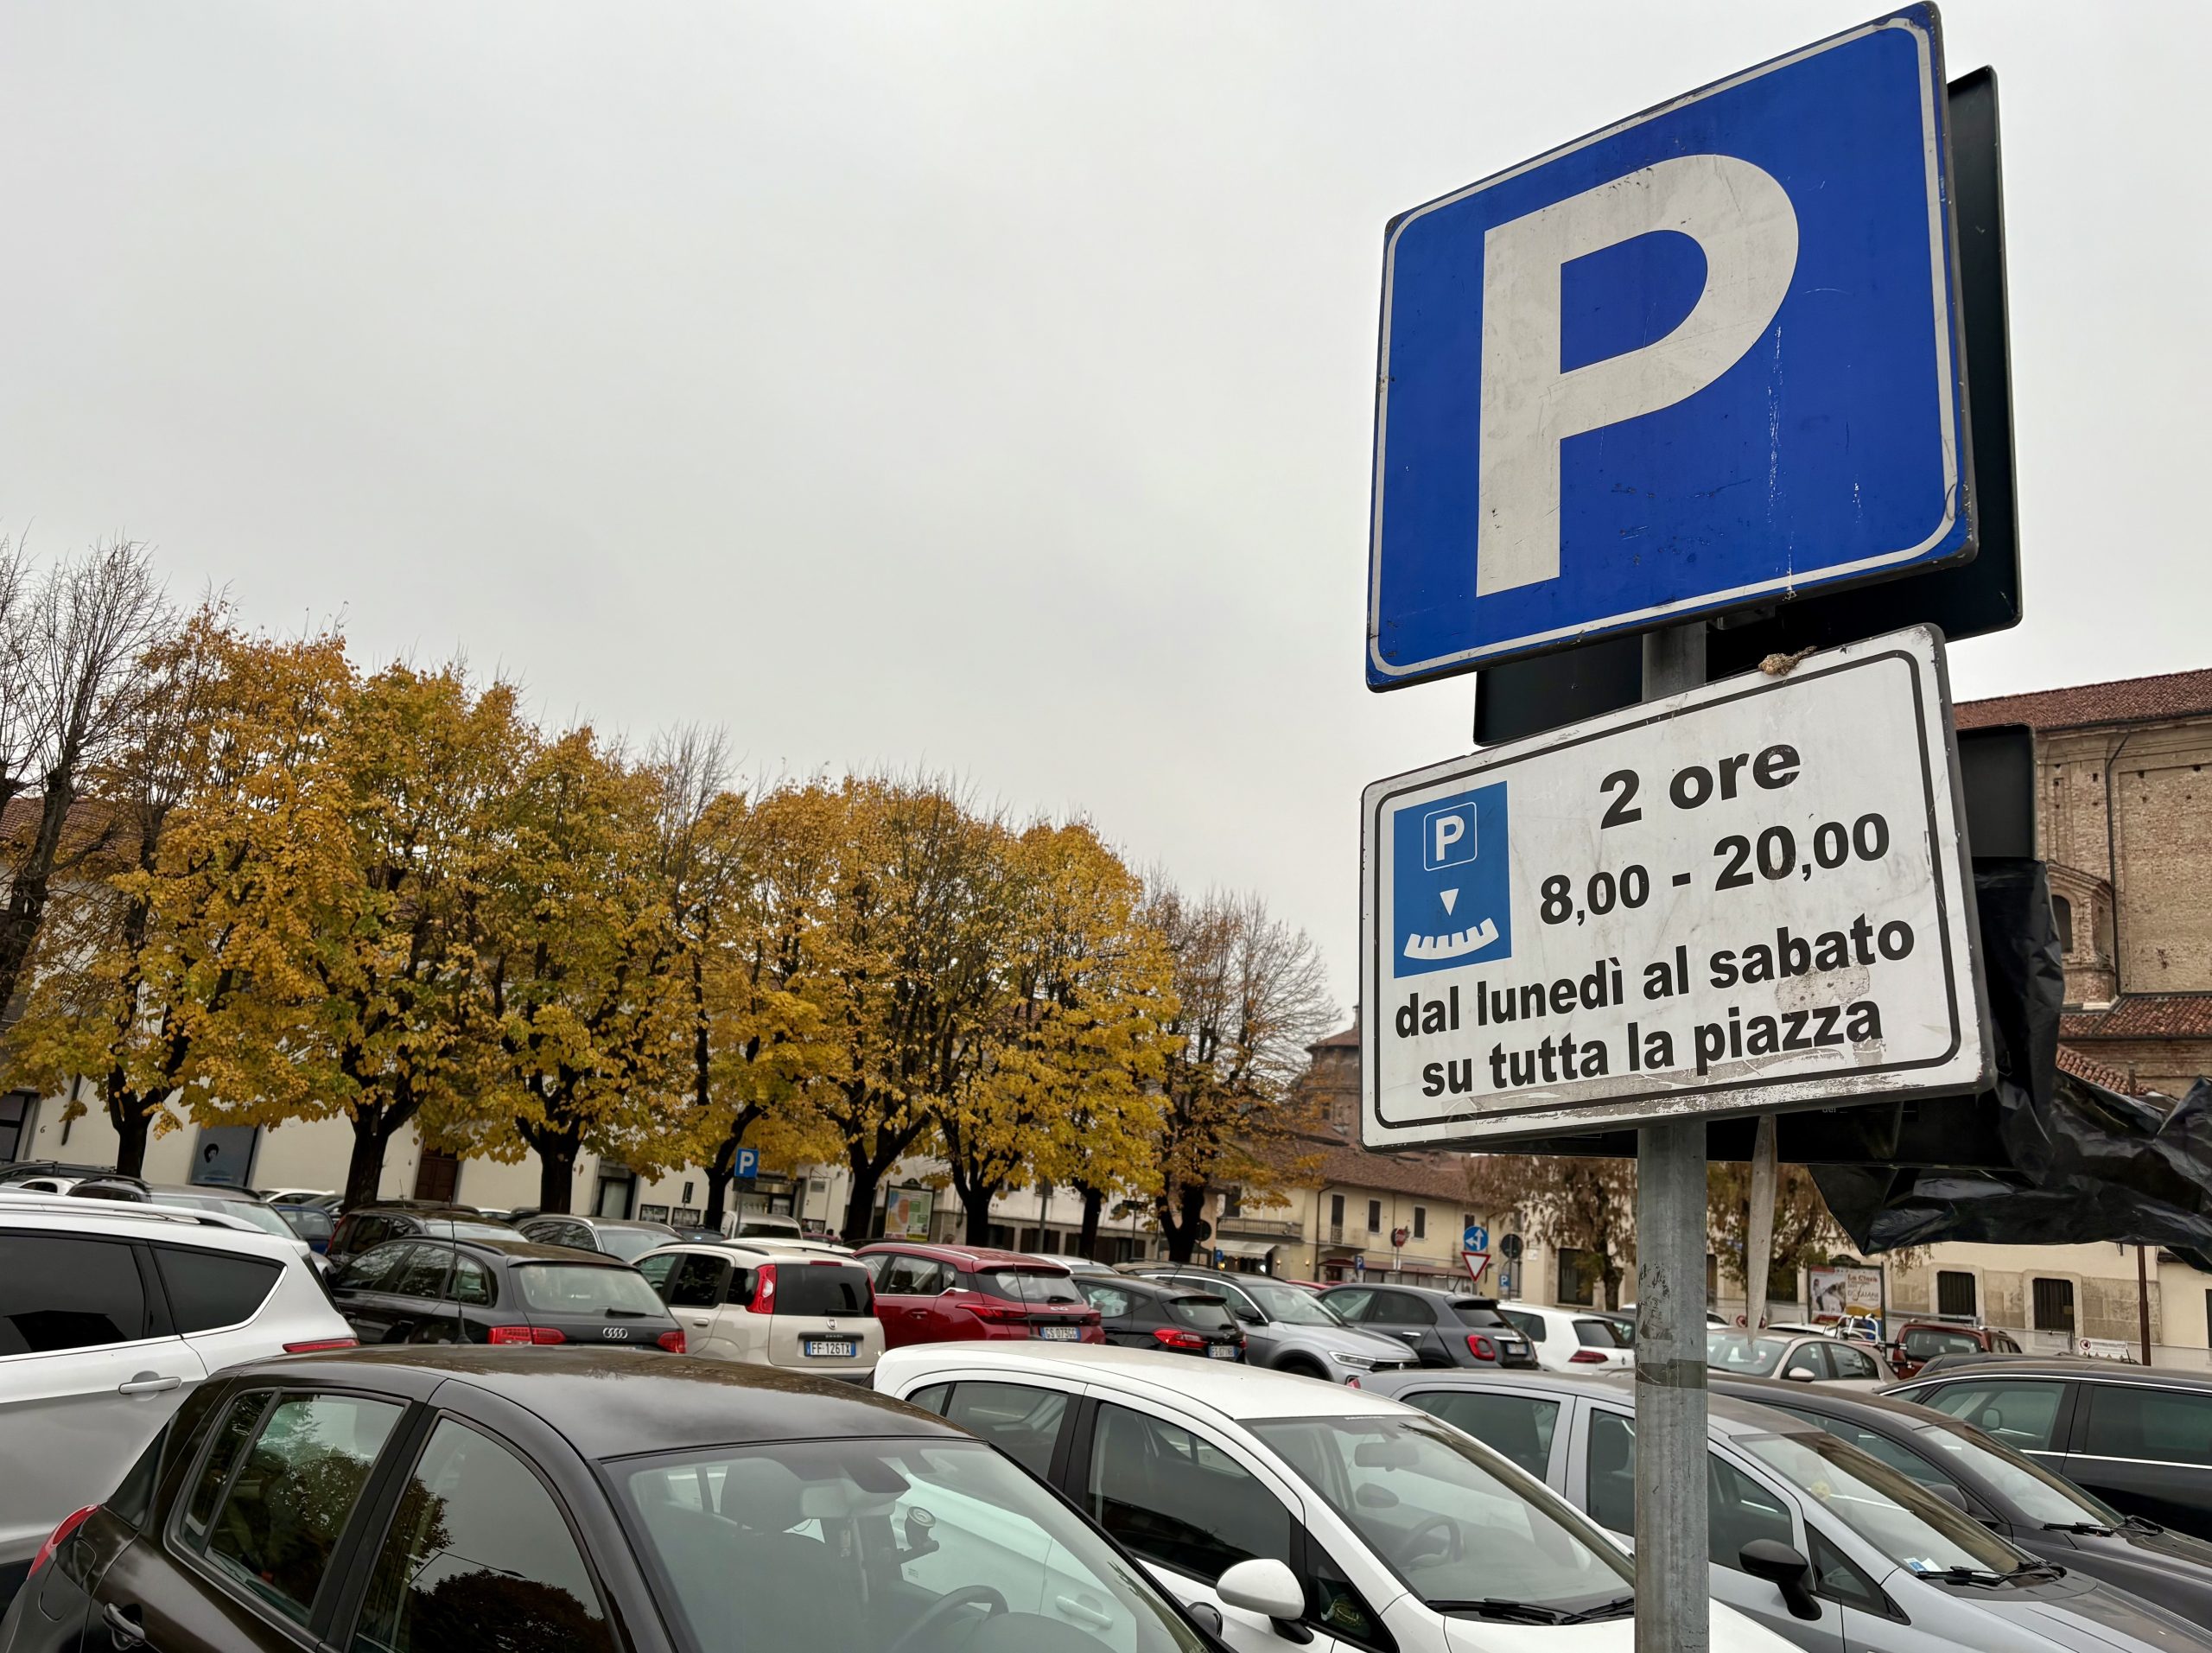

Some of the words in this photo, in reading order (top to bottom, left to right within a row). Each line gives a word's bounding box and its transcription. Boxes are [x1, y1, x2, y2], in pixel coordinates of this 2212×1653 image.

[1476, 153, 1799, 598] P
[1600, 770, 1643, 830] 2
[1669, 745, 1801, 810] ore
[1435, 815, 1465, 861] P
[1541, 864, 1649, 927] 8,00
[1673, 872, 1691, 887] -
[1714, 813, 1890, 892] 20,00
[1395, 986, 1459, 1039] dal
[1477, 957, 1624, 1027] lunedì
[1643, 945, 1689, 1001] al
[1710, 913, 1915, 989] sabato
[1421, 1059, 1472, 1098] su
[1489, 1033, 1610, 1089] tutta
[1628, 1021, 1675, 1072] la
[1694, 1001, 1884, 1077] piazza
[40, 1125, 47, 1134] 6
[739, 1151, 754, 1174] P
